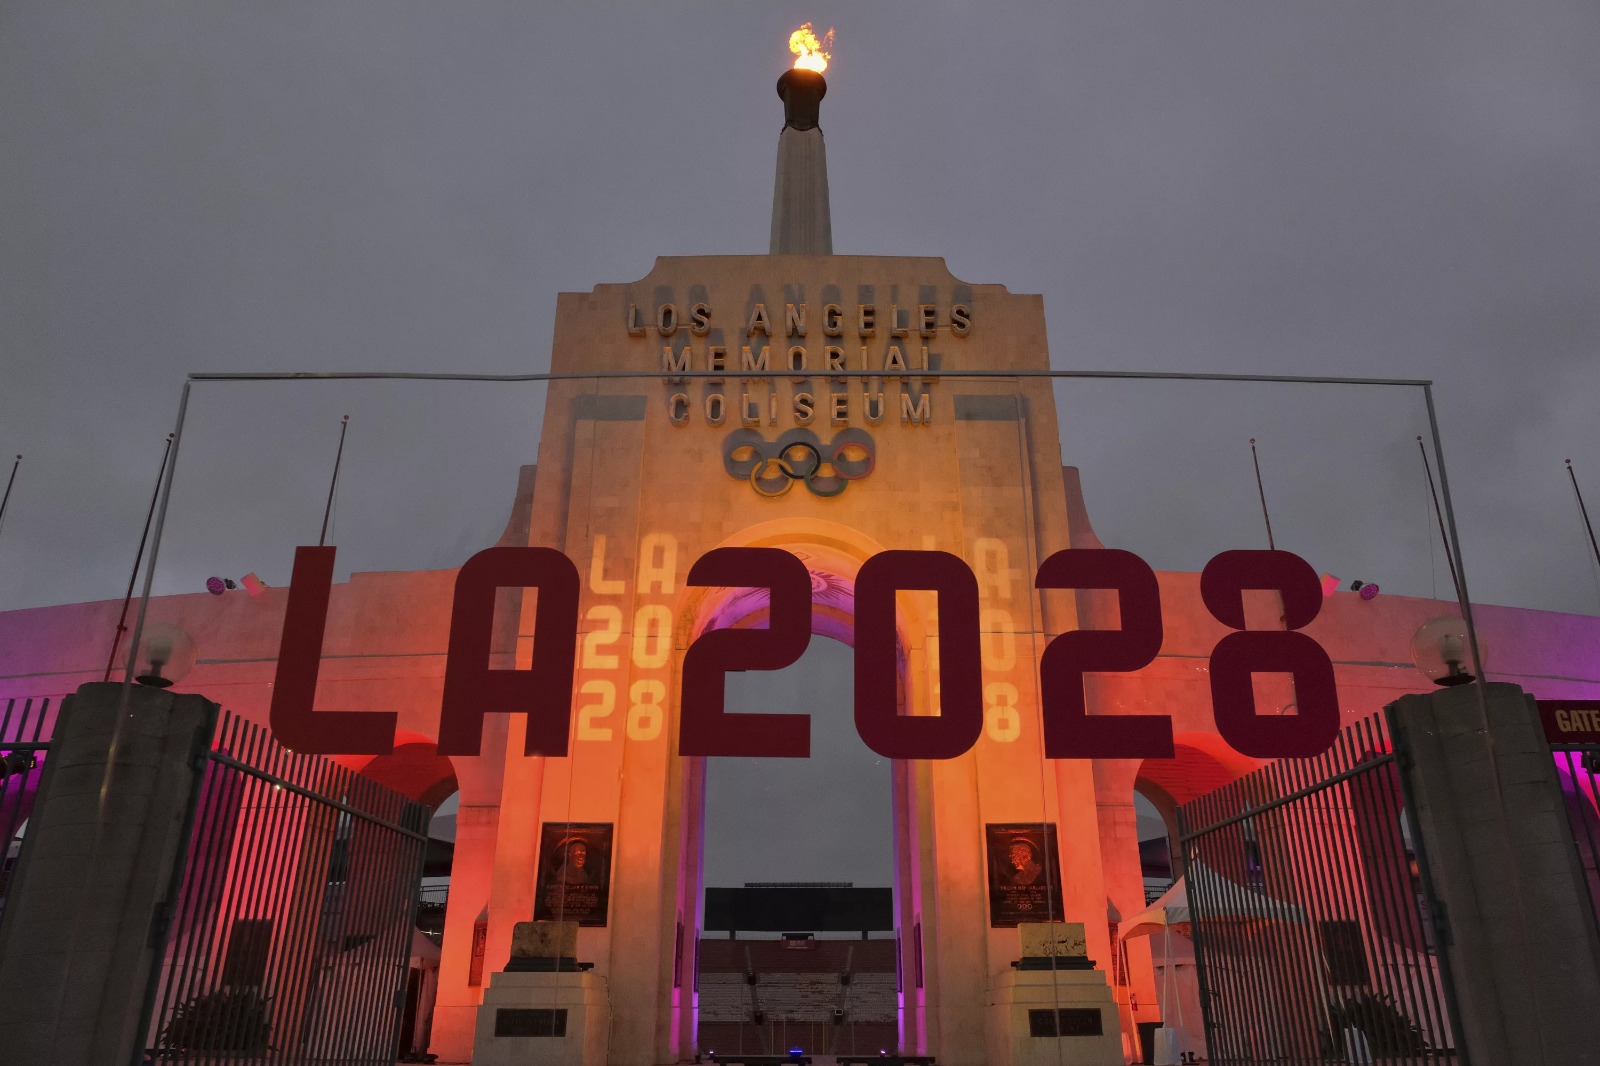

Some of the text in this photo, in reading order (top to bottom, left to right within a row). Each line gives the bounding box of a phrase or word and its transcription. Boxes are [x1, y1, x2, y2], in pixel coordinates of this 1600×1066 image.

[627, 302, 972, 338] LOS ANGELES
[662, 345, 941, 384] MEMORIAL
[668, 392, 932, 428] COLISEUM
[589, 532, 678, 595] LA
[269, 546, 1340, 759] LA 2028
[582, 604, 673, 669] 20
[576, 679, 666, 741] 28
[1555, 709, 1600, 732] GATE
